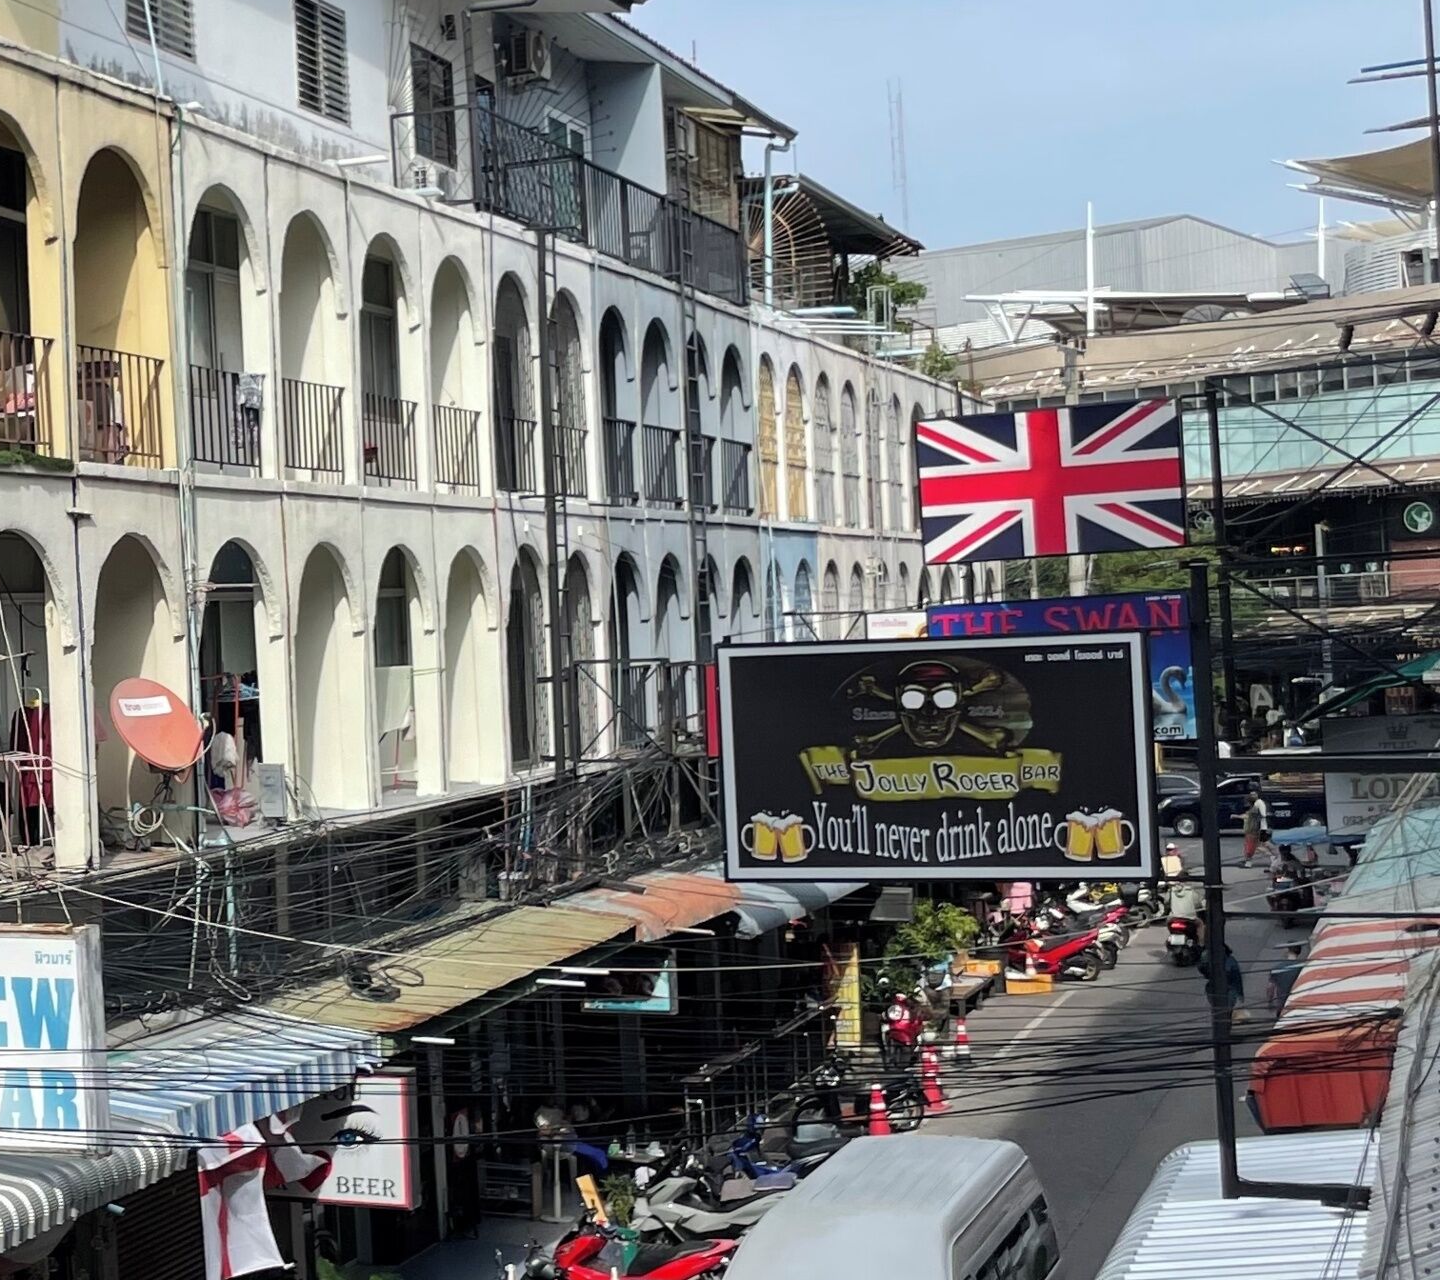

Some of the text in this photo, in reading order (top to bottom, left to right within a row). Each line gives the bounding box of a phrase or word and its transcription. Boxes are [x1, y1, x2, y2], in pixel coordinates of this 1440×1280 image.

[1043, 599, 1180, 636] SWAN
[815, 761, 1061, 794] THE JOLLY ROGER BAR
[812, 800, 1053, 863] You'll never drink alone
[335, 1175, 396, 1199] BEER
